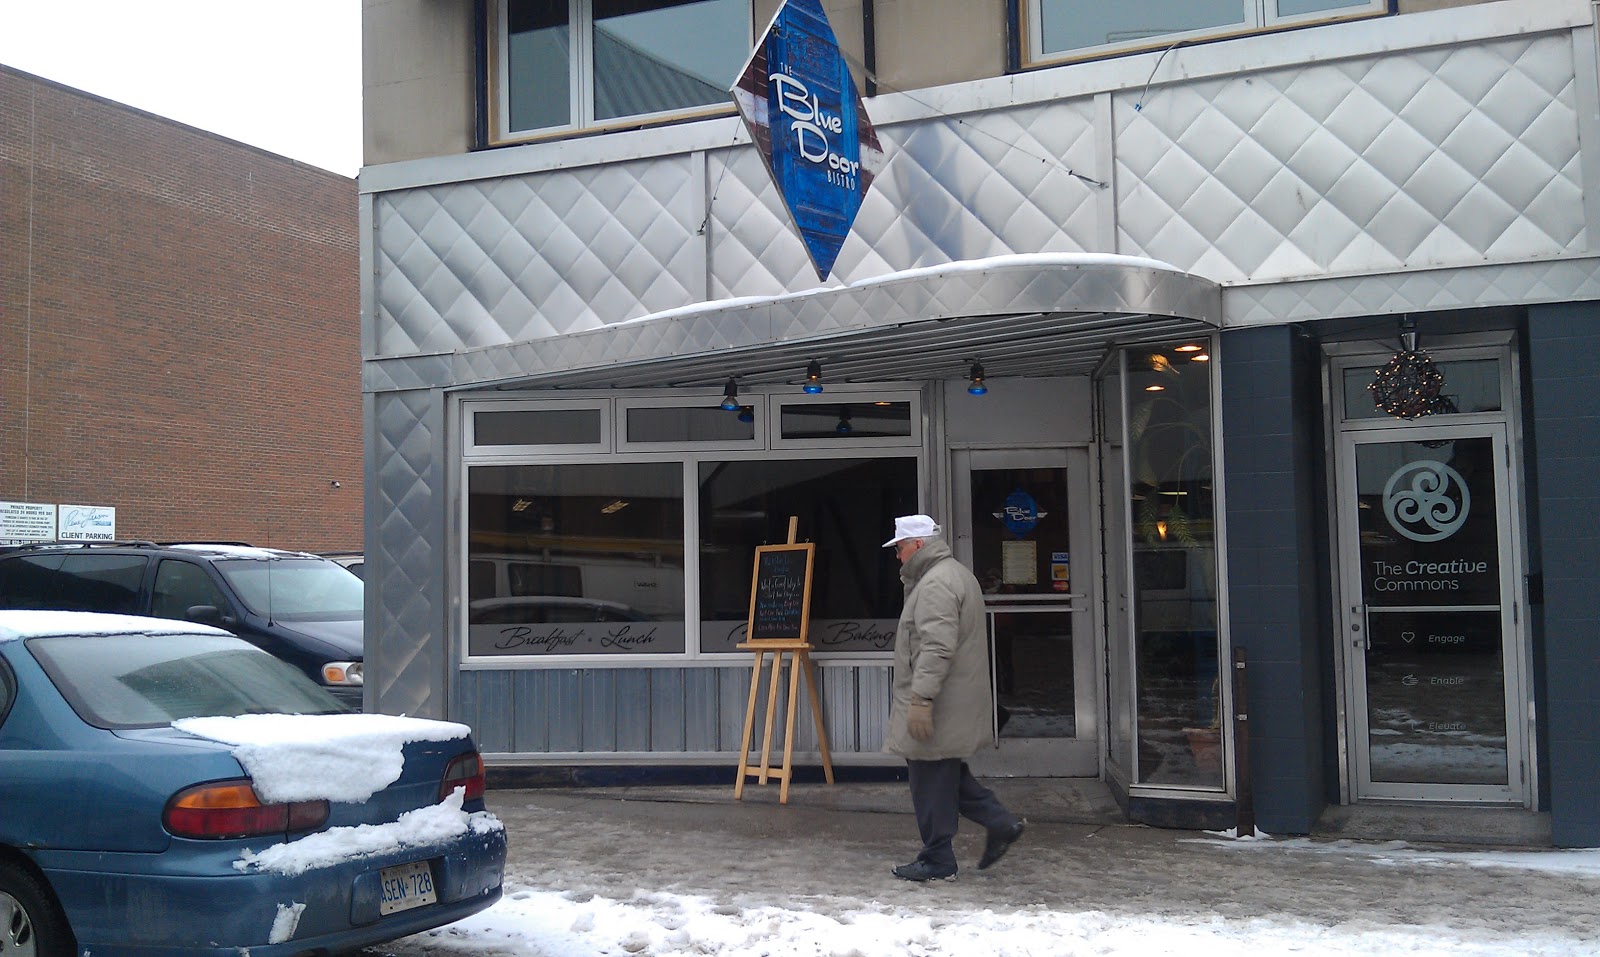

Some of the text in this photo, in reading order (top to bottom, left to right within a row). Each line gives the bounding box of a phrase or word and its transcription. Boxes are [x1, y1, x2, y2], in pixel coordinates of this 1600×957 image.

[780, 62, 792, 76] THE
[769, 72, 842, 134] Blue
[791, 120, 859, 177] Door
[827, 169, 856, 191] BISTRO
[1004, 506, 1031, 514] Blue
[1373, 559, 1487, 575] The Creative
[1374, 577, 1459, 591] Commons
[495, 625, 657, 651] Breakfast Lunch
[821, 622, 895, 648] Baking
[1428, 634, 1465, 644] Engage
[1430, 676, 1464, 685] Enable
[1429, 722, 1466, 730] Elevate
[409, 872, 432, 896] 728
